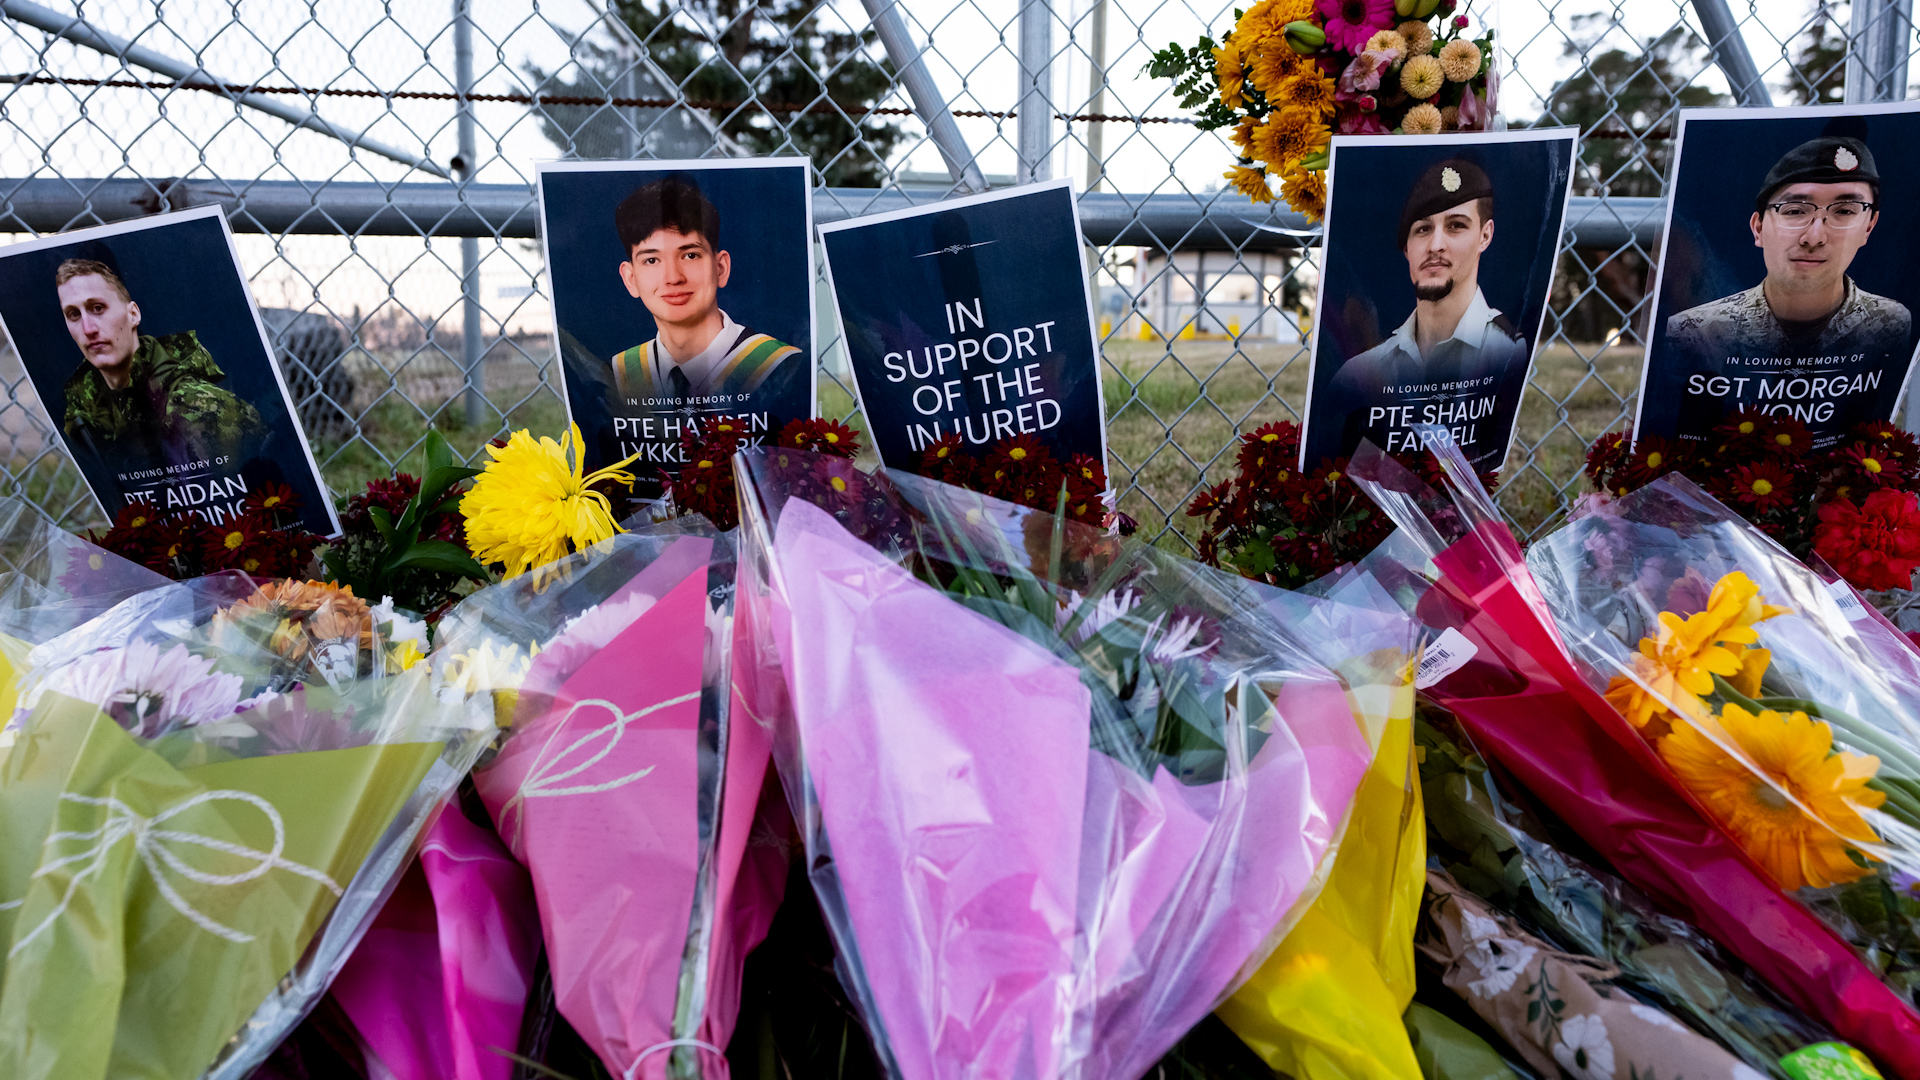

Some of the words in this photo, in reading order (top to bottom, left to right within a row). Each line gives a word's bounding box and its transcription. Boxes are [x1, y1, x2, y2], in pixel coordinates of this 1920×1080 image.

[945, 297, 984, 334] IN
[883, 321, 1055, 383] SUPPORT
[1726, 356, 1740, 365] IN
[1744, 357, 1792, 366] LOVING
[1796, 355, 1847, 366] MEMORY
[1850, 353, 1865, 363] OF
[627, 398, 638, 406] IN
[642, 397, 682, 406] LOVING
[686, 394, 733, 405] MEMORY
[737, 393, 751, 402] OF
[912, 379, 961, 416] OF
[973, 363, 1044, 405] THE
[1382, 385, 1394, 394] IN
[1398, 383, 1438, 394] LOVING
[1441, 379, 1480, 391] MEMORY
[1483, 376, 1494, 385] OF
[1687, 374, 1751, 398] SGT
[1757, 369, 1883, 400] MORGAN
[1368, 405, 1415, 428] PTE
[1421, 394, 1496, 426] SHAUN
[613, 417, 655, 438] PTE
[118, 473, 128, 482] IN
[128, 467, 163, 480] LOVING
[166, 459, 211, 475] MEMORY
[215, 455, 230, 465] OF
[167, 473, 248, 509] AIDAN
